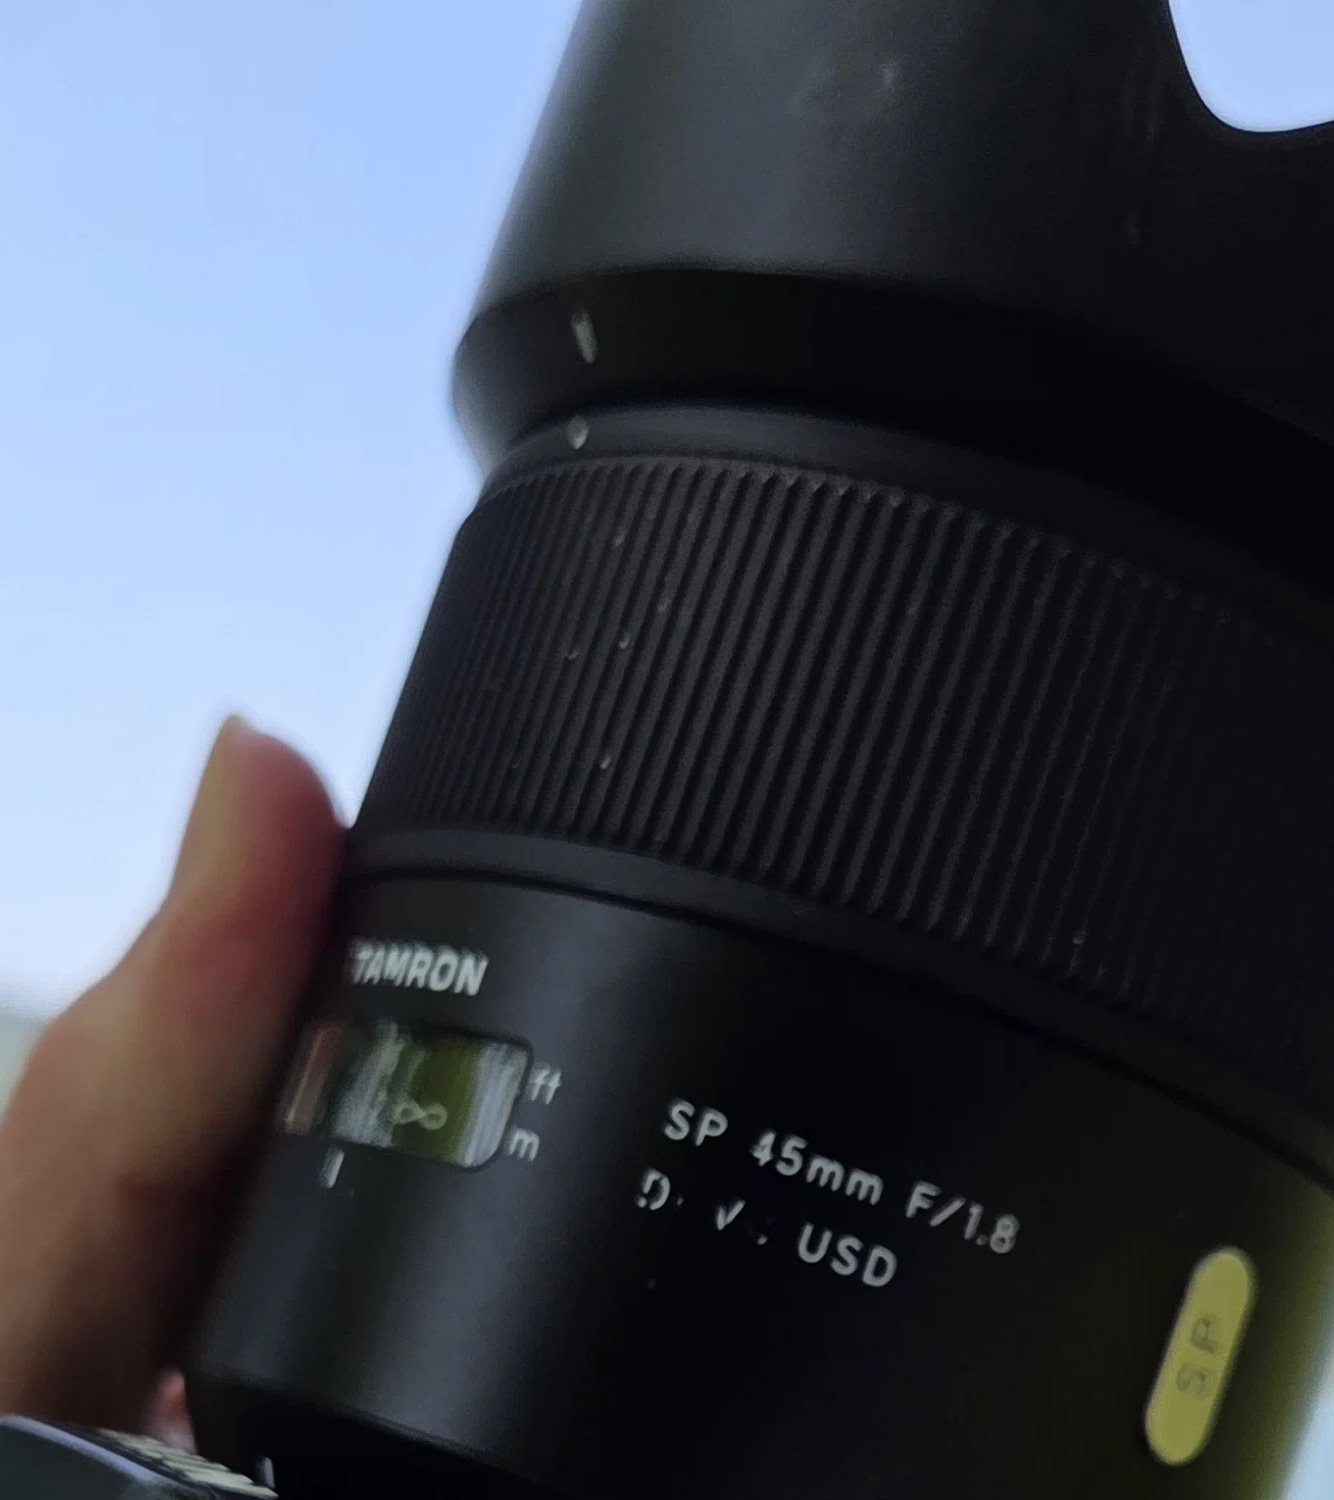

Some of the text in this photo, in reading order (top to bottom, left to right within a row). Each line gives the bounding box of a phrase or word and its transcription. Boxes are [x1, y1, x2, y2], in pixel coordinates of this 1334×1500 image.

[350, 938, 489, 997] TAMRON
[509, 1126, 540, 1162] m
[663, 1098, 1020, 1254] SP 45mm F/1.8
[796, 1221, 898, 1288] USD
